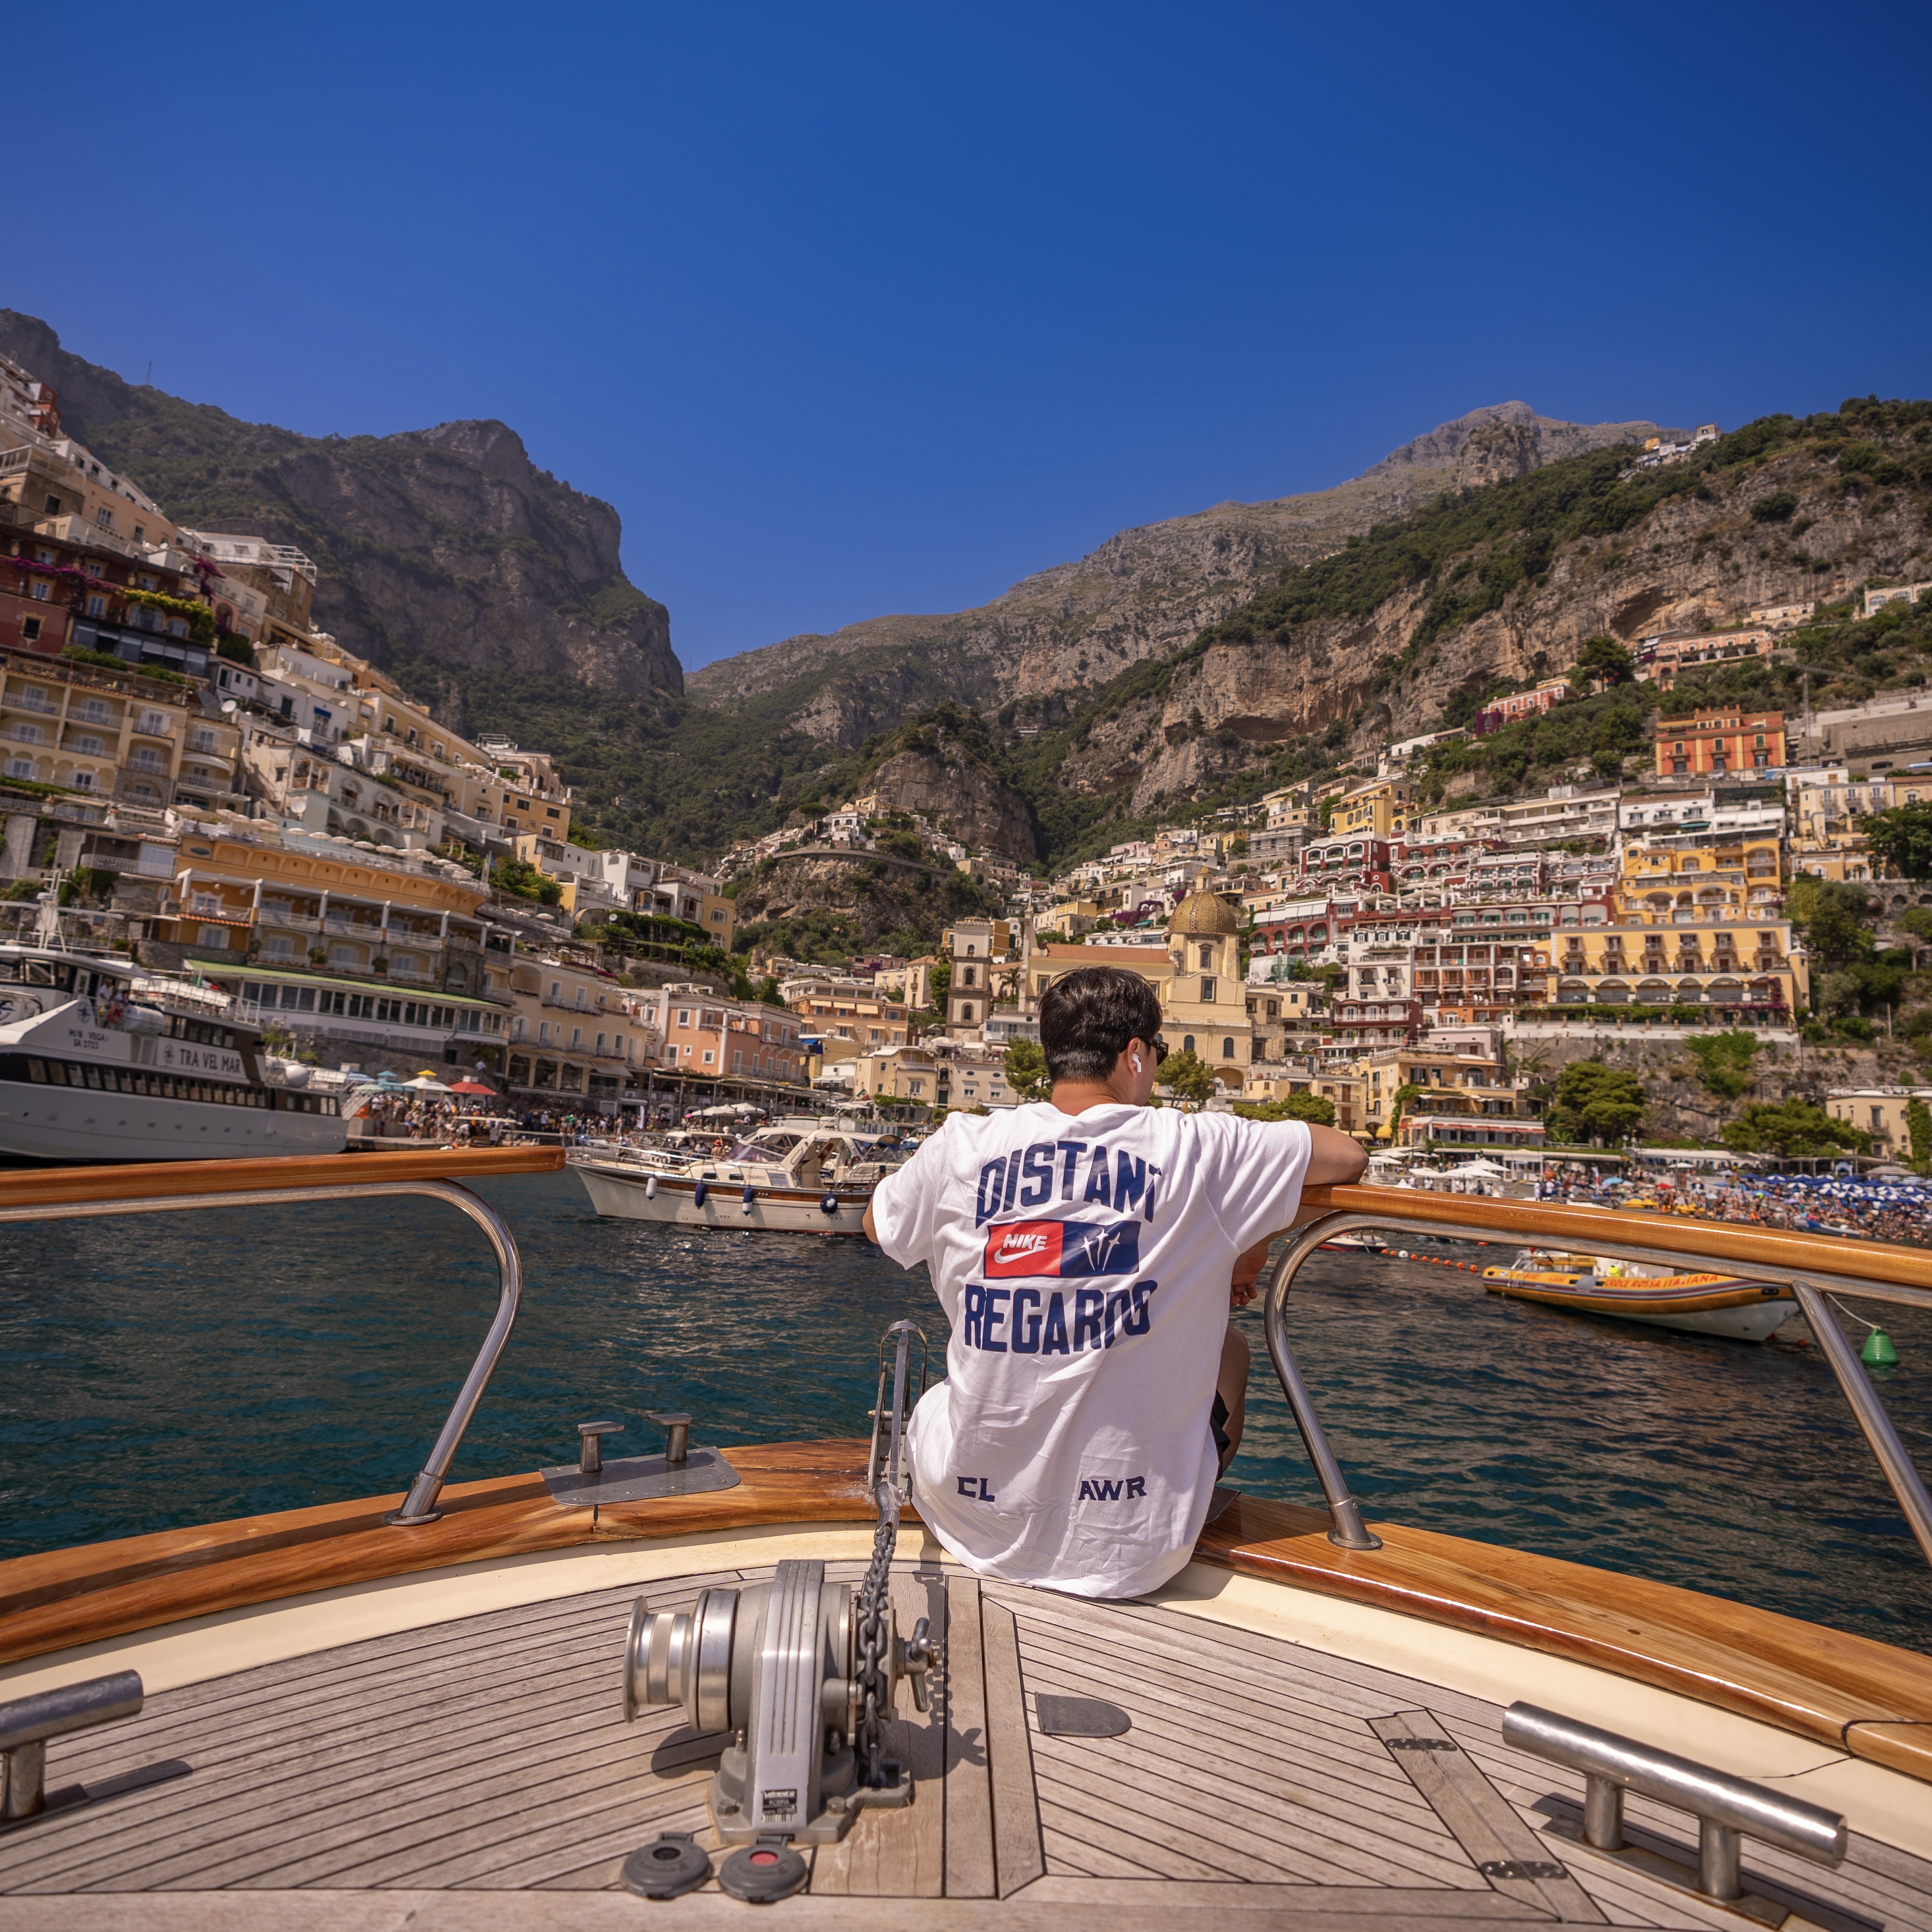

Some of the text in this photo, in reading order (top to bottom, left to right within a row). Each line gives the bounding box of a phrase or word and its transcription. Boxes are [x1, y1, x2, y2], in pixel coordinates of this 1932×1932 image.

[222, 1055, 241, 1073] MAR
[976, 1141, 1162, 1229] DISTANT
[1002, 1233, 1048, 1250] NIKE
[1604, 1274, 1718, 1288] CROCE ROSSA ITALIANA
[965, 1280, 1158, 1355] REGARDS
[957, 1476, 1147, 1502] CL AWR
